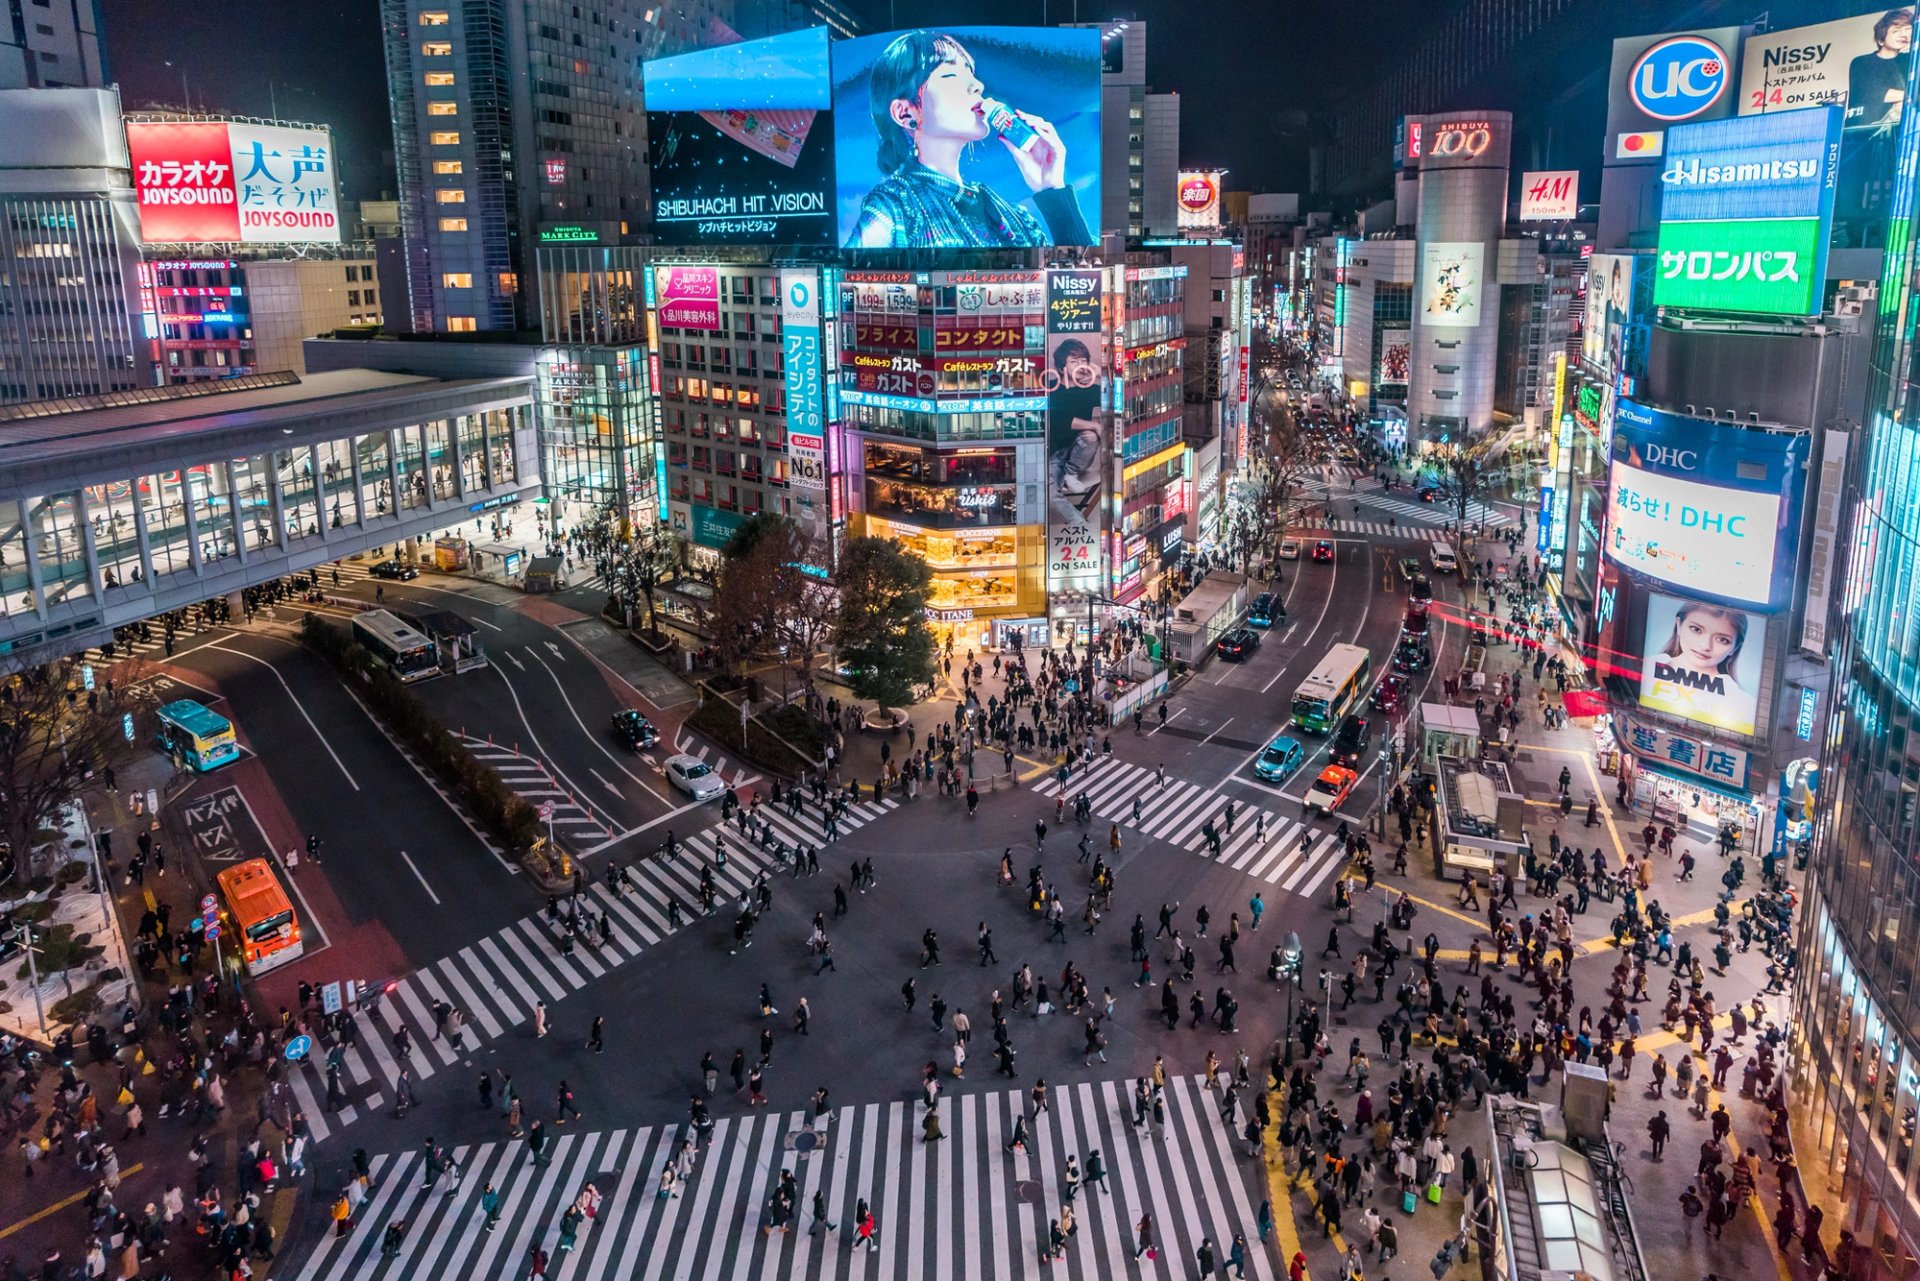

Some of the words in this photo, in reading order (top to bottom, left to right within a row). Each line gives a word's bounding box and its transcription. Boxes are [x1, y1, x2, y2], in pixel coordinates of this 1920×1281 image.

[1763, 43, 1832, 68] Nissy
[1786, 94, 1805, 104] ON
[1809, 89, 1837, 102] SALE
[1441, 122, 1490, 131] SHIBUYA
[237, 140, 327, 184] 大声
[1825, 143, 1838, 188] サロンパス
[139, 160, 229, 186] カラオケ
[1661, 159, 1818, 185] Hisamitsu
[142, 187, 234, 205] JOYSOUND
[241, 184, 330, 209] だそうぜ
[1182, 187, 1210, 202] 楽園
[1528, 176, 1572, 202] H&M
[657, 197, 736, 216] SHIBUHACHI
[742, 195, 767, 214] HIT
[771, 192, 824, 212] VISION
[243, 210, 334, 228] JOYSOUND
[698, 220, 777, 233] シブハチヒットビジョン
[157, 261, 188, 269] カラオケ
[189, 261, 226, 269] JOYSOUND
[1660, 250, 1799, 283] サロンパス
[682, 273, 714, 284] 品川スキン
[845, 272, 911, 283] しゃぶしゃぶバイキング
[947, 272, 1041, 284] しゃぶしゃぶバイキング
[1053, 275, 1097, 292] Nissy
[683, 284, 712, 294] クリニック
[841, 292, 853, 303] 9F
[987, 289, 1041, 306] しゃぶ葉
[1051, 297, 1099, 311] 4大ドーム
[667, 309, 717, 324] 品川美容外科
[787, 311, 814, 320] eyecity
[1060, 309, 1091, 320] ツアー
[857, 327, 916, 344] プライス
[936, 330, 1021, 345] コンタクト
[891, 356, 922, 373] ガスト
[996, 358, 1036, 373] ガスト
[788, 335, 806, 425] アイシティ
[804, 336, 819, 426] コンタクトの
[843, 372, 857, 383] 7F
[877, 373, 913, 393] ガスト
[972, 399, 1046, 411] 英会話イーオン
[1627, 411, 1652, 425] Channel
[1646, 443, 1698, 471] DHC
[1680, 506, 1747, 538] DHC
[1060, 525, 1089, 535] ベスト
[1163, 525, 1182, 548] LUSH
[1054, 535, 1095, 546] アルバム
[1060, 546, 1089, 561] 2.4
[1052, 562, 1070, 571] ON
[1073, 560, 1098, 570] SALE
[1654, 661, 1726, 696] DMM
